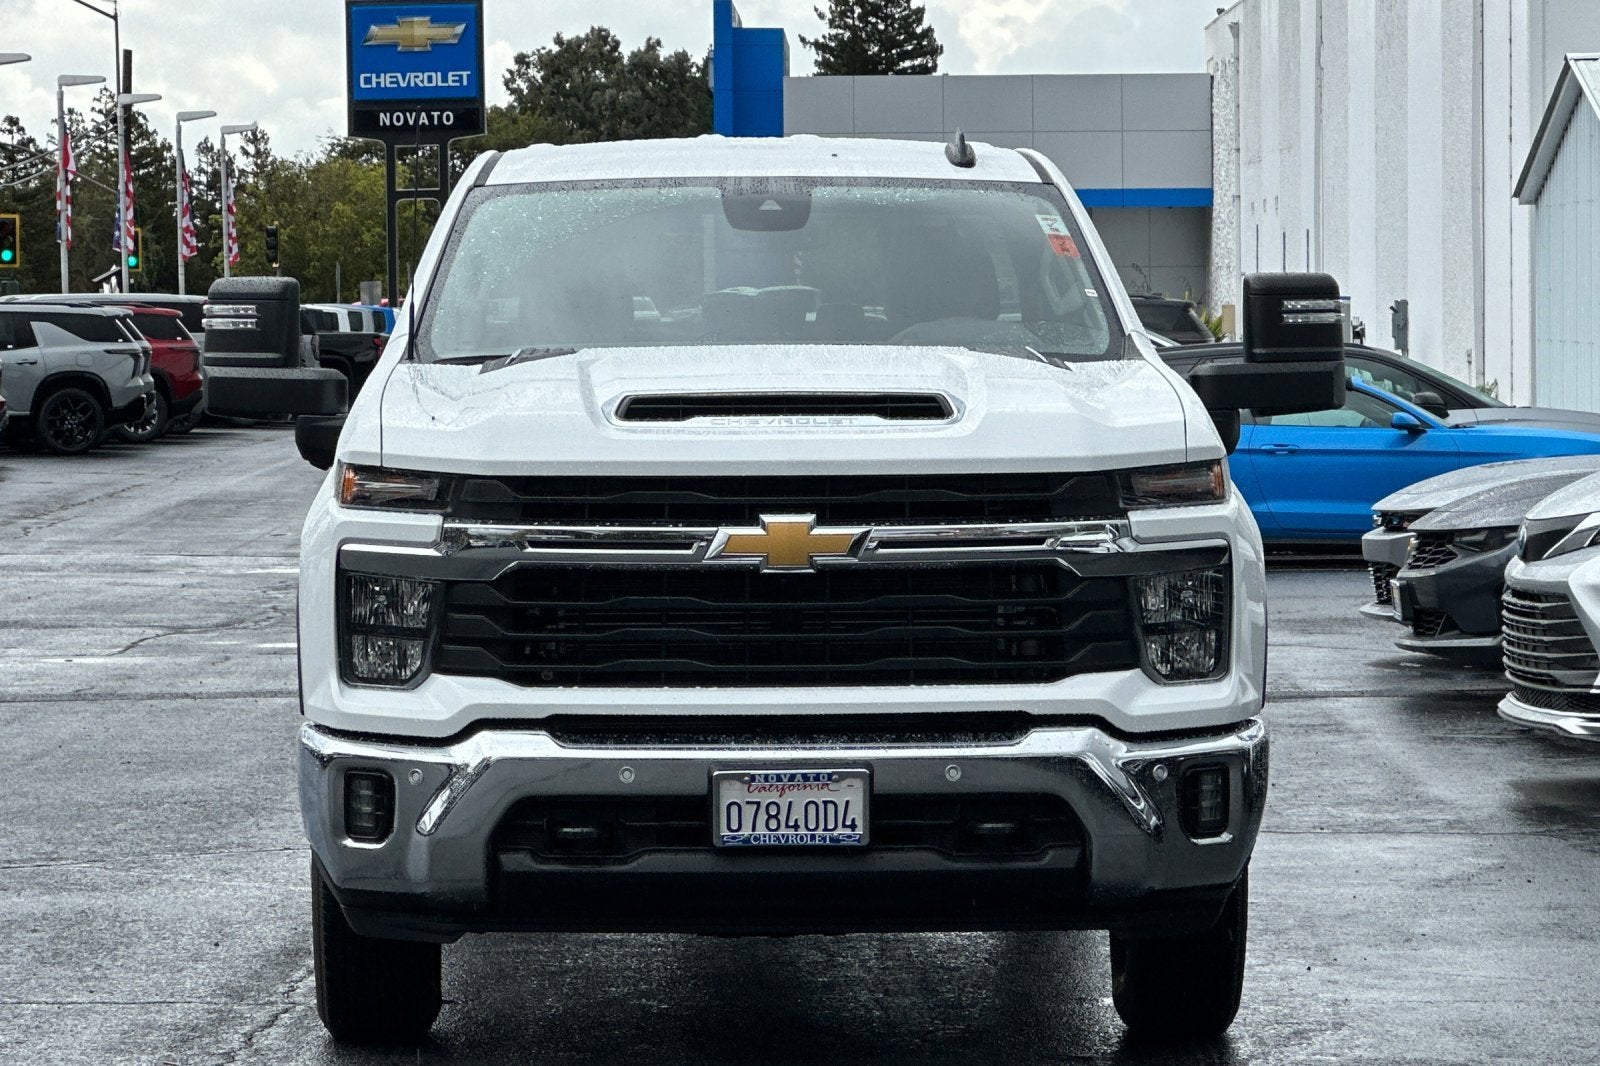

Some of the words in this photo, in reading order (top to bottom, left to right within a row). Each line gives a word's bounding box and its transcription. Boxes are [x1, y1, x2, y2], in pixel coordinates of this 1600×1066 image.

[360, 71, 471, 88] CHEVROLET
[379, 111, 454, 126] NOVATO
[755, 773, 829, 783] NOVATO
[726, 800, 857, 832] 07840D4
[750, 834, 832, 844] CHEVROLET
